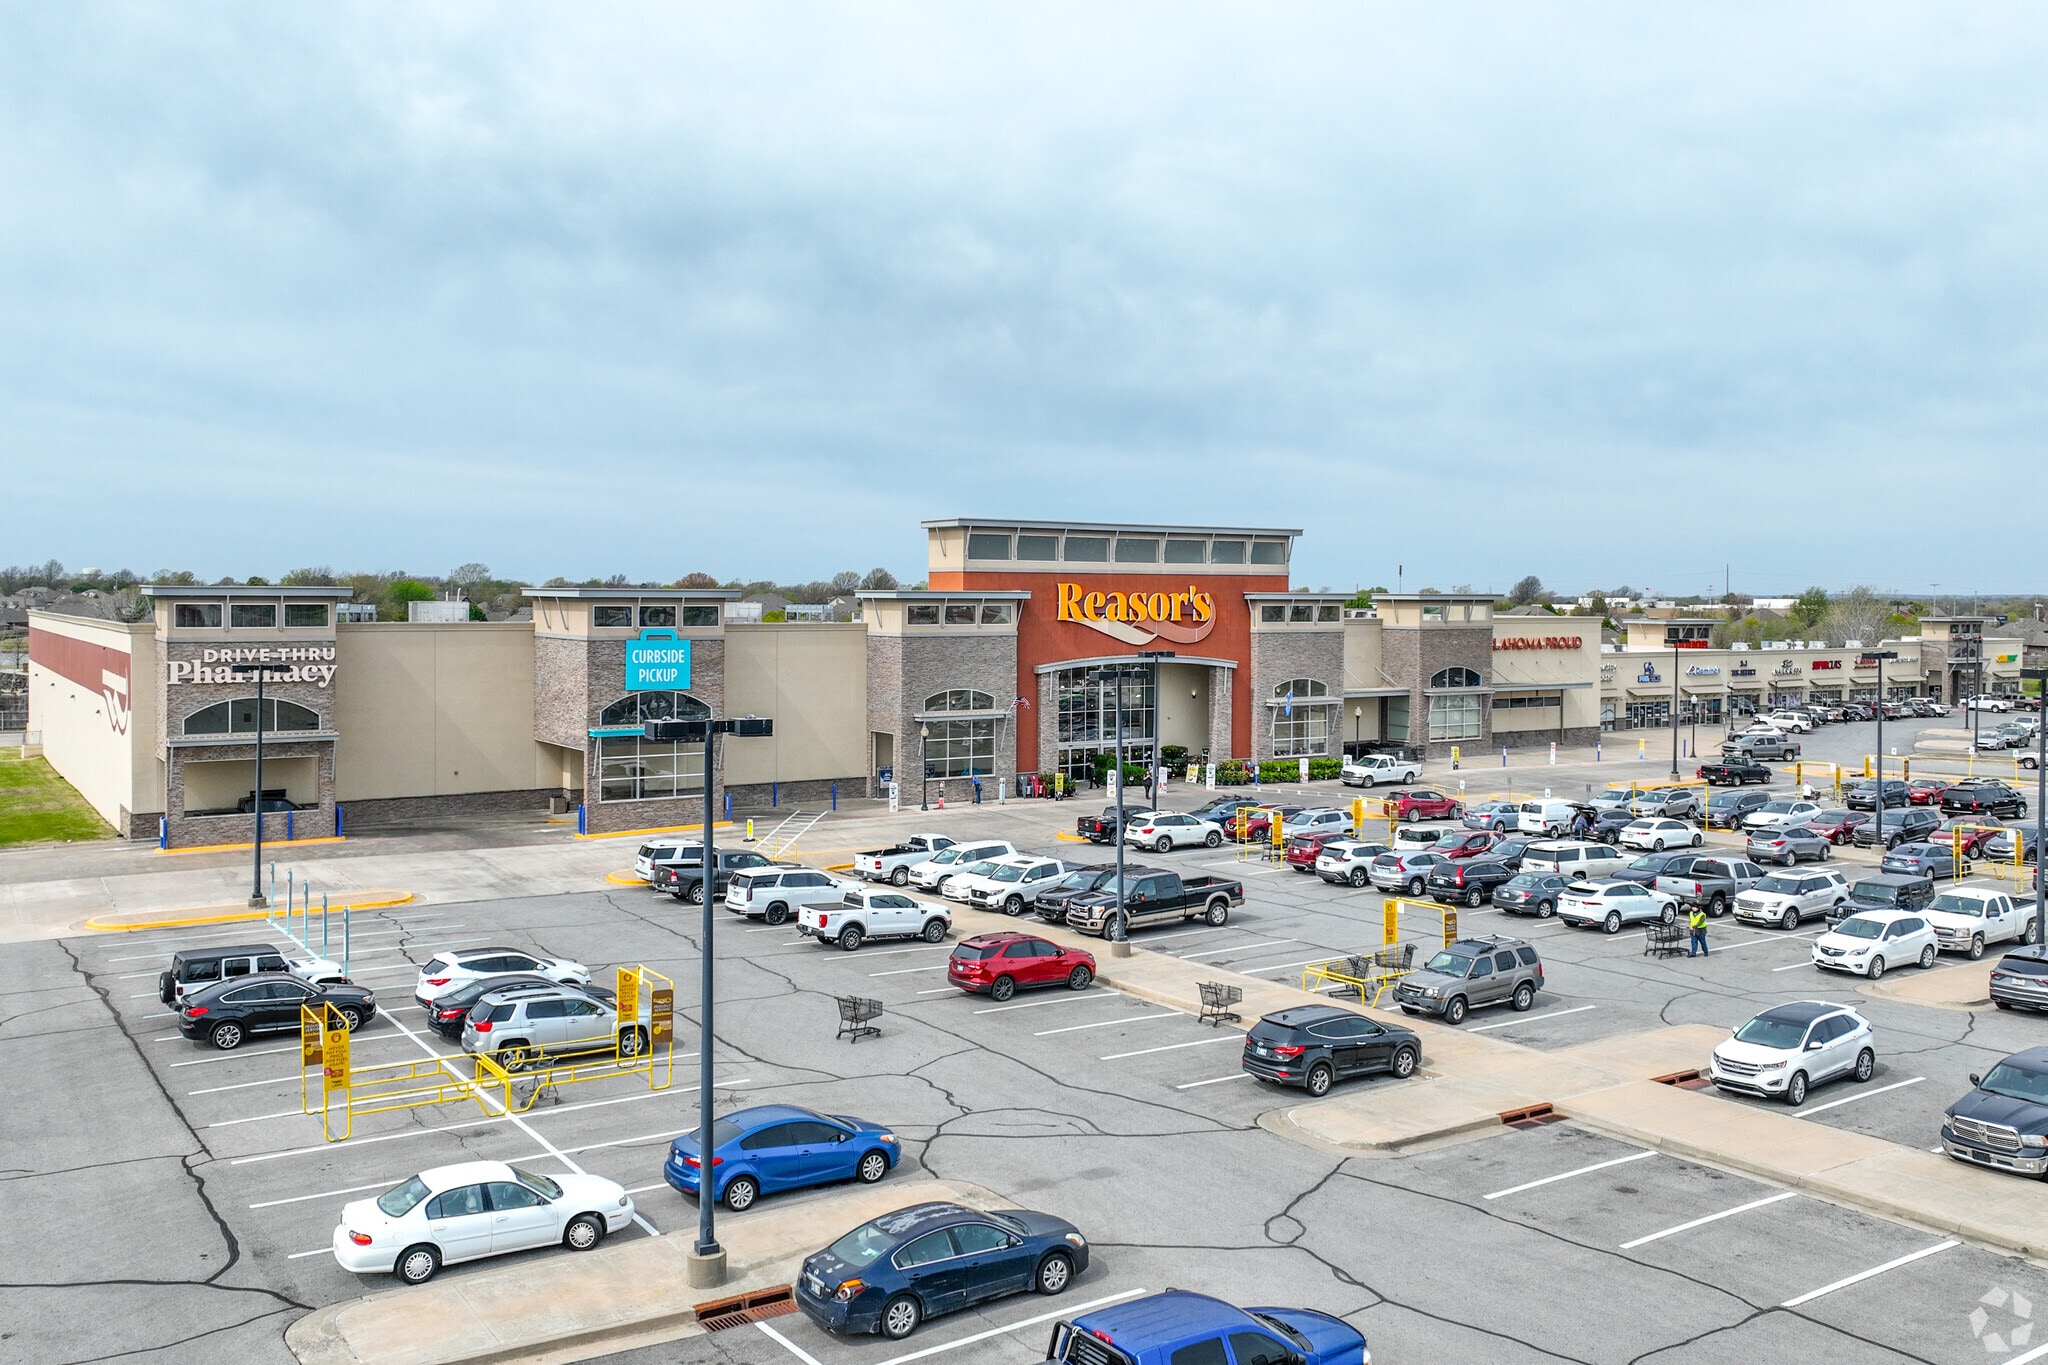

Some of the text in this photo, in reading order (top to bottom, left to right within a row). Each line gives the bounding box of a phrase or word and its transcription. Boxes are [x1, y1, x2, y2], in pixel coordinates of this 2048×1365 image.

[1057, 582, 1212, 622] Reasor's
[1492, 636, 1583, 651] LAHOMA PROUD
[203, 647, 337, 663] DRIVE-THRU
[632, 649, 685, 664] CURBSIDE
[638, 668, 678, 683] PICKUP
